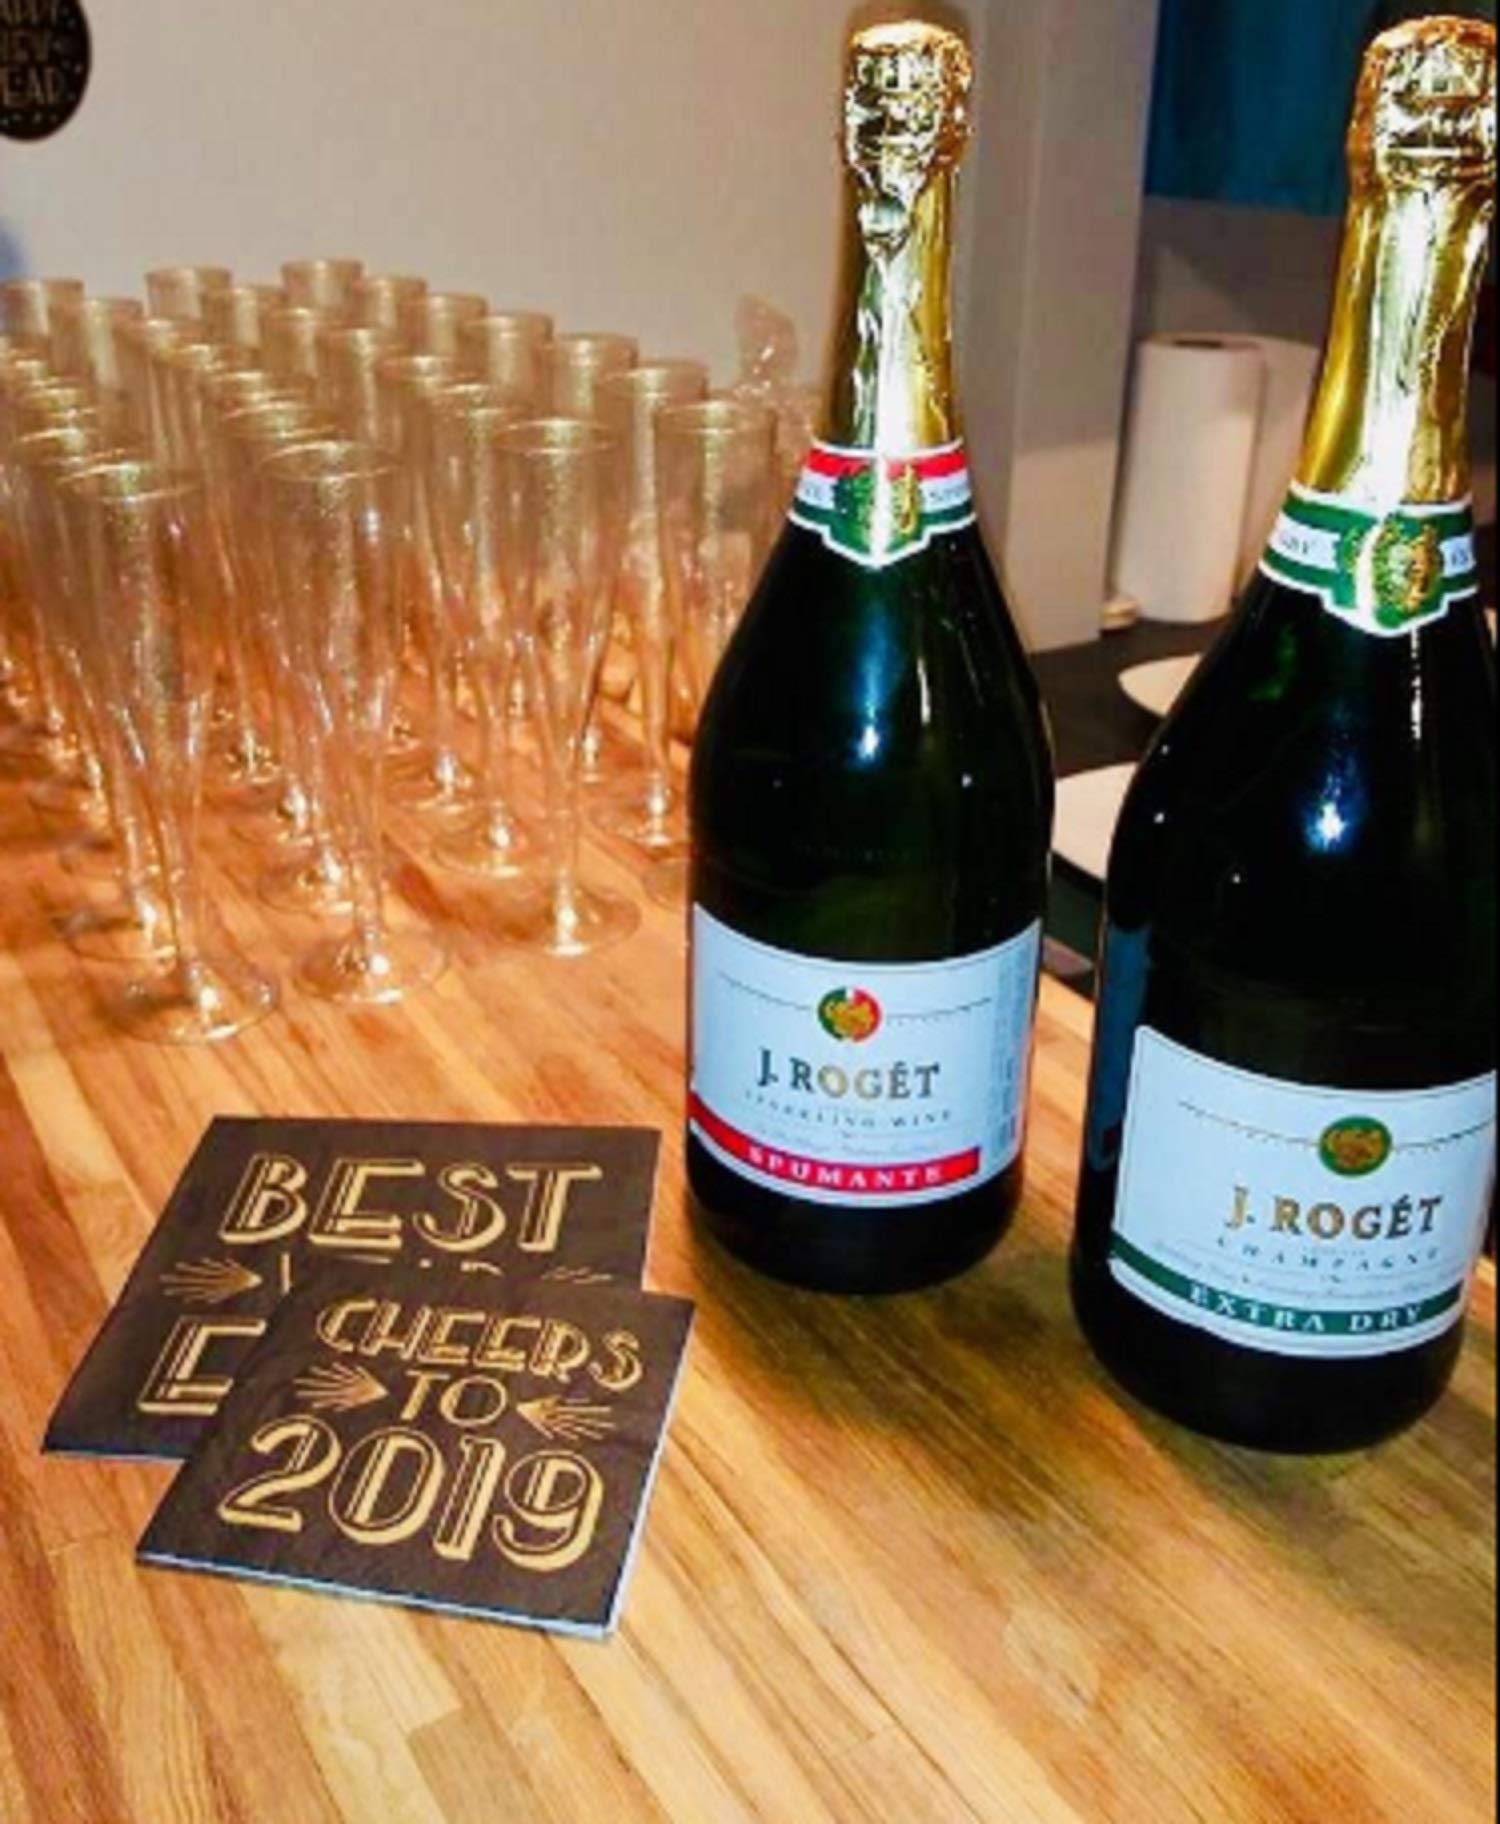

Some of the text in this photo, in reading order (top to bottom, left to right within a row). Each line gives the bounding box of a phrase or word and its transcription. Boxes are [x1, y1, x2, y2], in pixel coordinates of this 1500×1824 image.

[757, 1046, 940, 1100] J. ROGÉT
[749, 1146, 943, 1188] SPUMANTE
[218, 1151, 603, 1254] BEST
[1224, 1184, 1444, 1240] J. ROGÉT
[1217, 1236, 1439, 1271] CHAMPAGNE
[1189, 1282, 1327, 1332] EXTRA
[1349, 1303, 1423, 1332] DRY
[315, 1298, 645, 1391] CHEERS
[400, 1369, 509, 1427] TO
[217, 1413, 605, 1572] 2019
